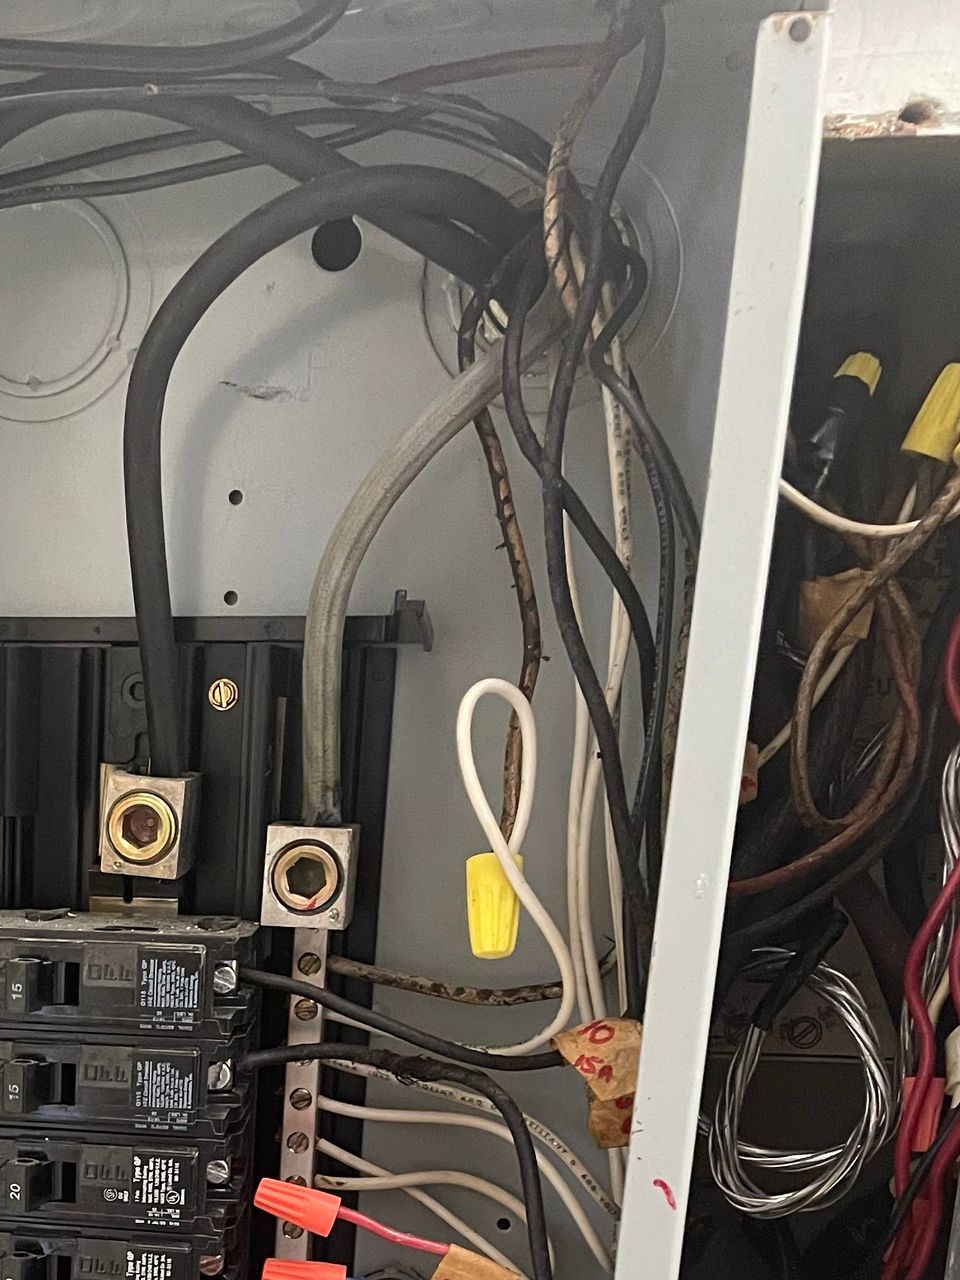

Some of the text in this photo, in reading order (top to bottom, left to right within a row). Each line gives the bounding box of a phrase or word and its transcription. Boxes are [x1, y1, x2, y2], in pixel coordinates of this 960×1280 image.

[11, 983, 23, 1000] 15
[8, 1084, 19, 1099] 15
[9, 1183, 21, 1200] 20
